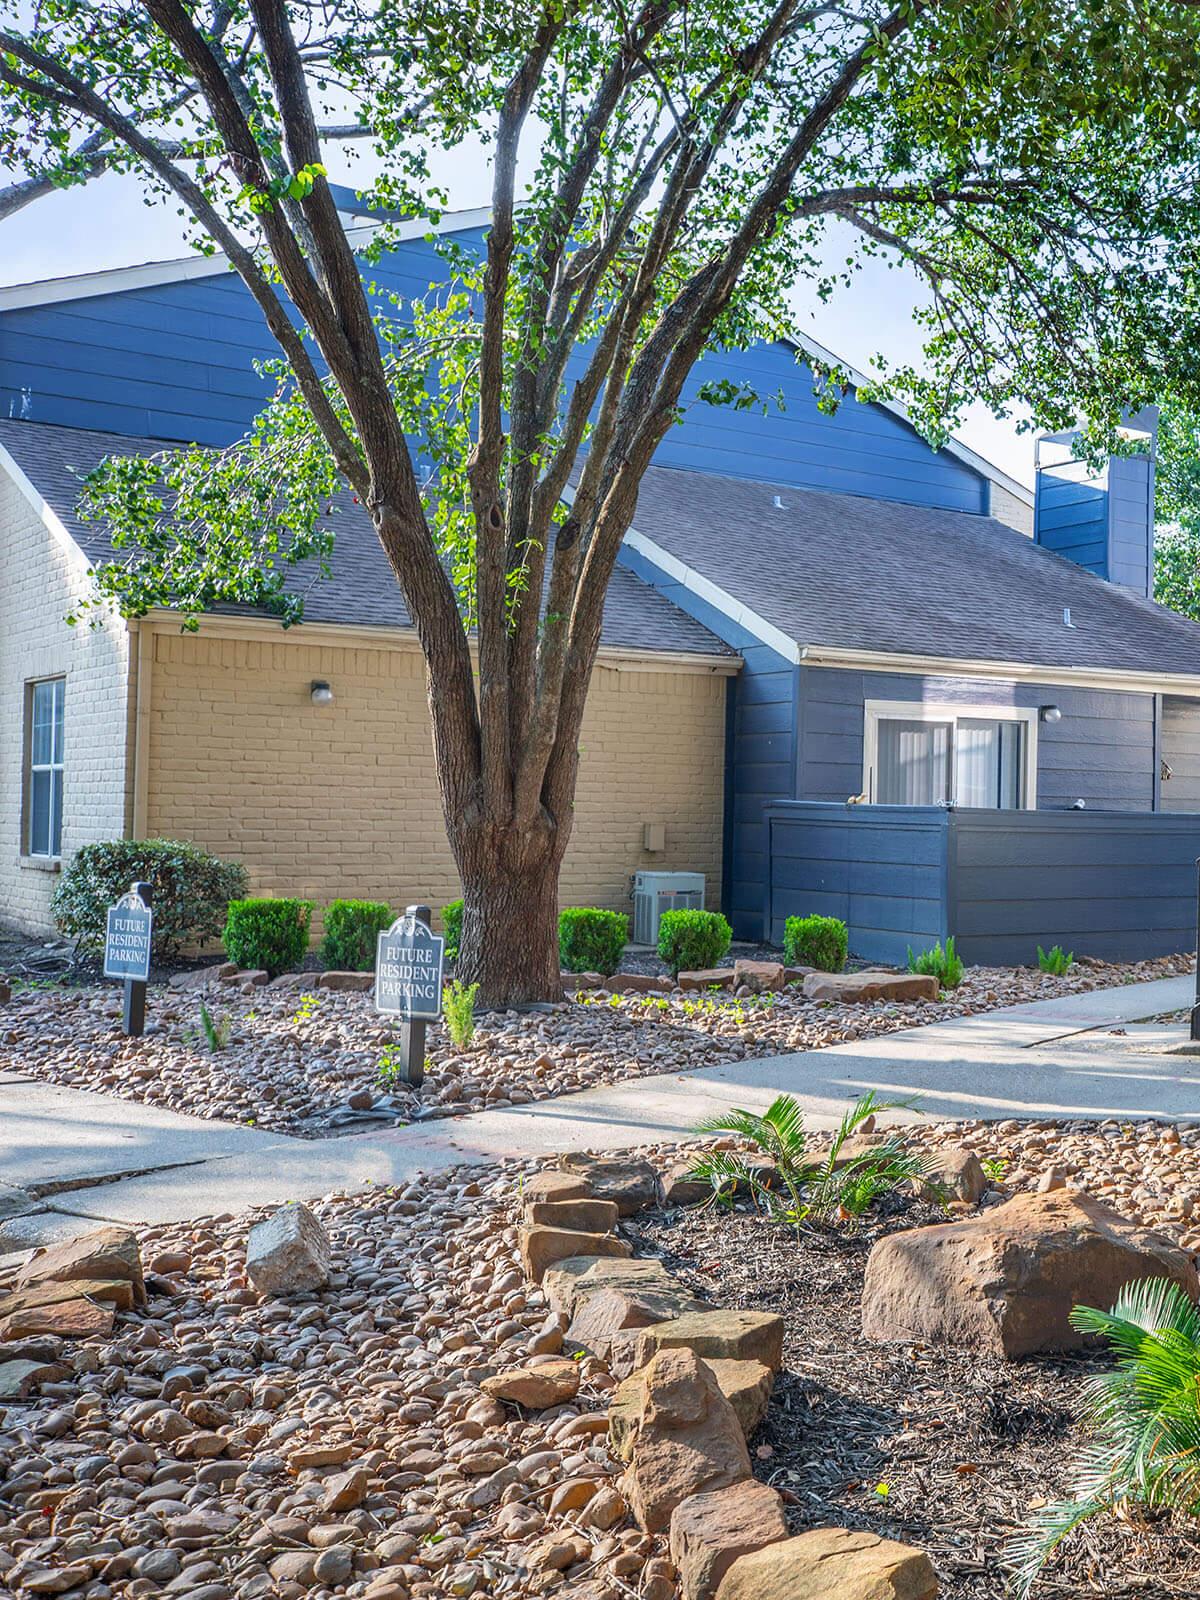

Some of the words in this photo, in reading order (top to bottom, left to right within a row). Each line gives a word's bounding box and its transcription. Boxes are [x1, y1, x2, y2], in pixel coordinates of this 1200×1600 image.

[114, 919, 145, 932] FUTURE
[109, 934, 148, 948] RESIDENT
[110, 948, 146, 964] PARKING
[386, 946, 433, 963] FUTURE
[380, 963, 438, 981] RESIDENT
[382, 981, 435, 999] PARKING
